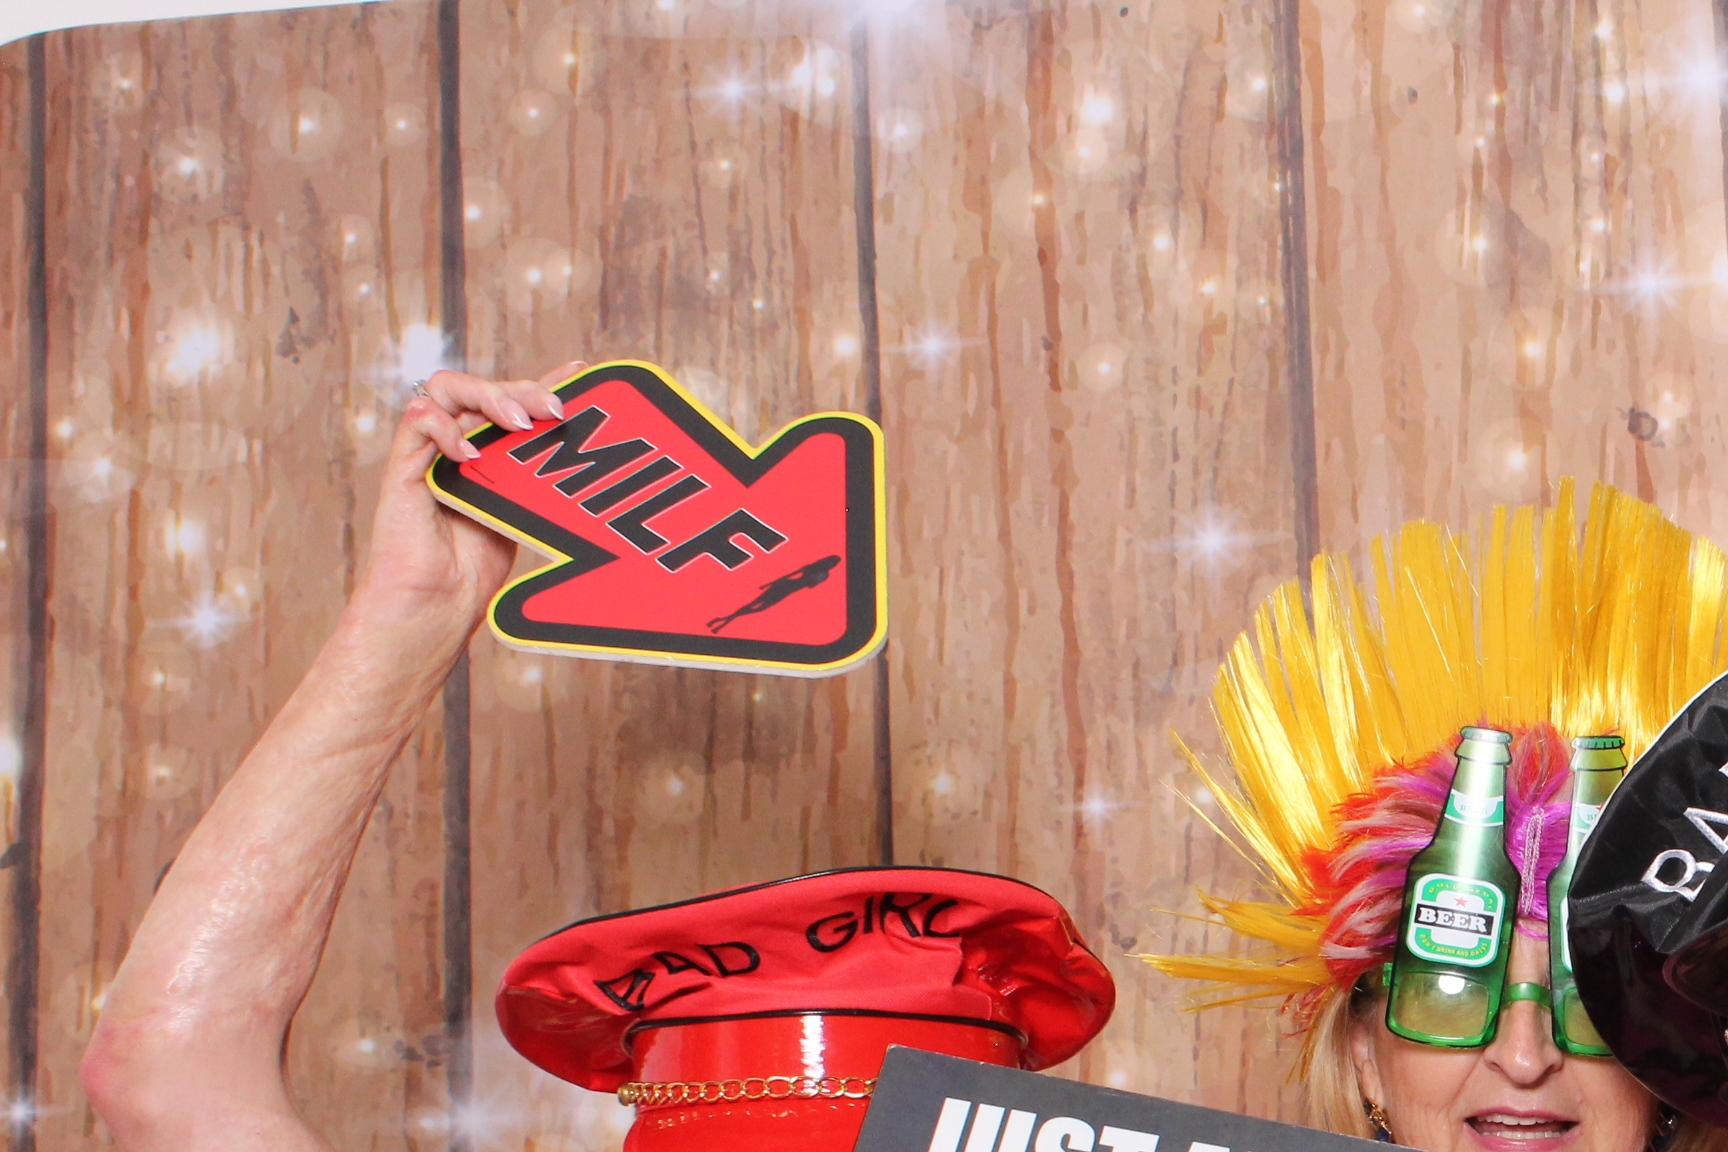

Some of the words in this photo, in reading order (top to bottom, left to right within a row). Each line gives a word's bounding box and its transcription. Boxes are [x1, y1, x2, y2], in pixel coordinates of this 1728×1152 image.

[506, 405, 789, 573] MILF
[1418, 907, 1487, 933] BEER
[593, 942, 761, 1011] BAD
